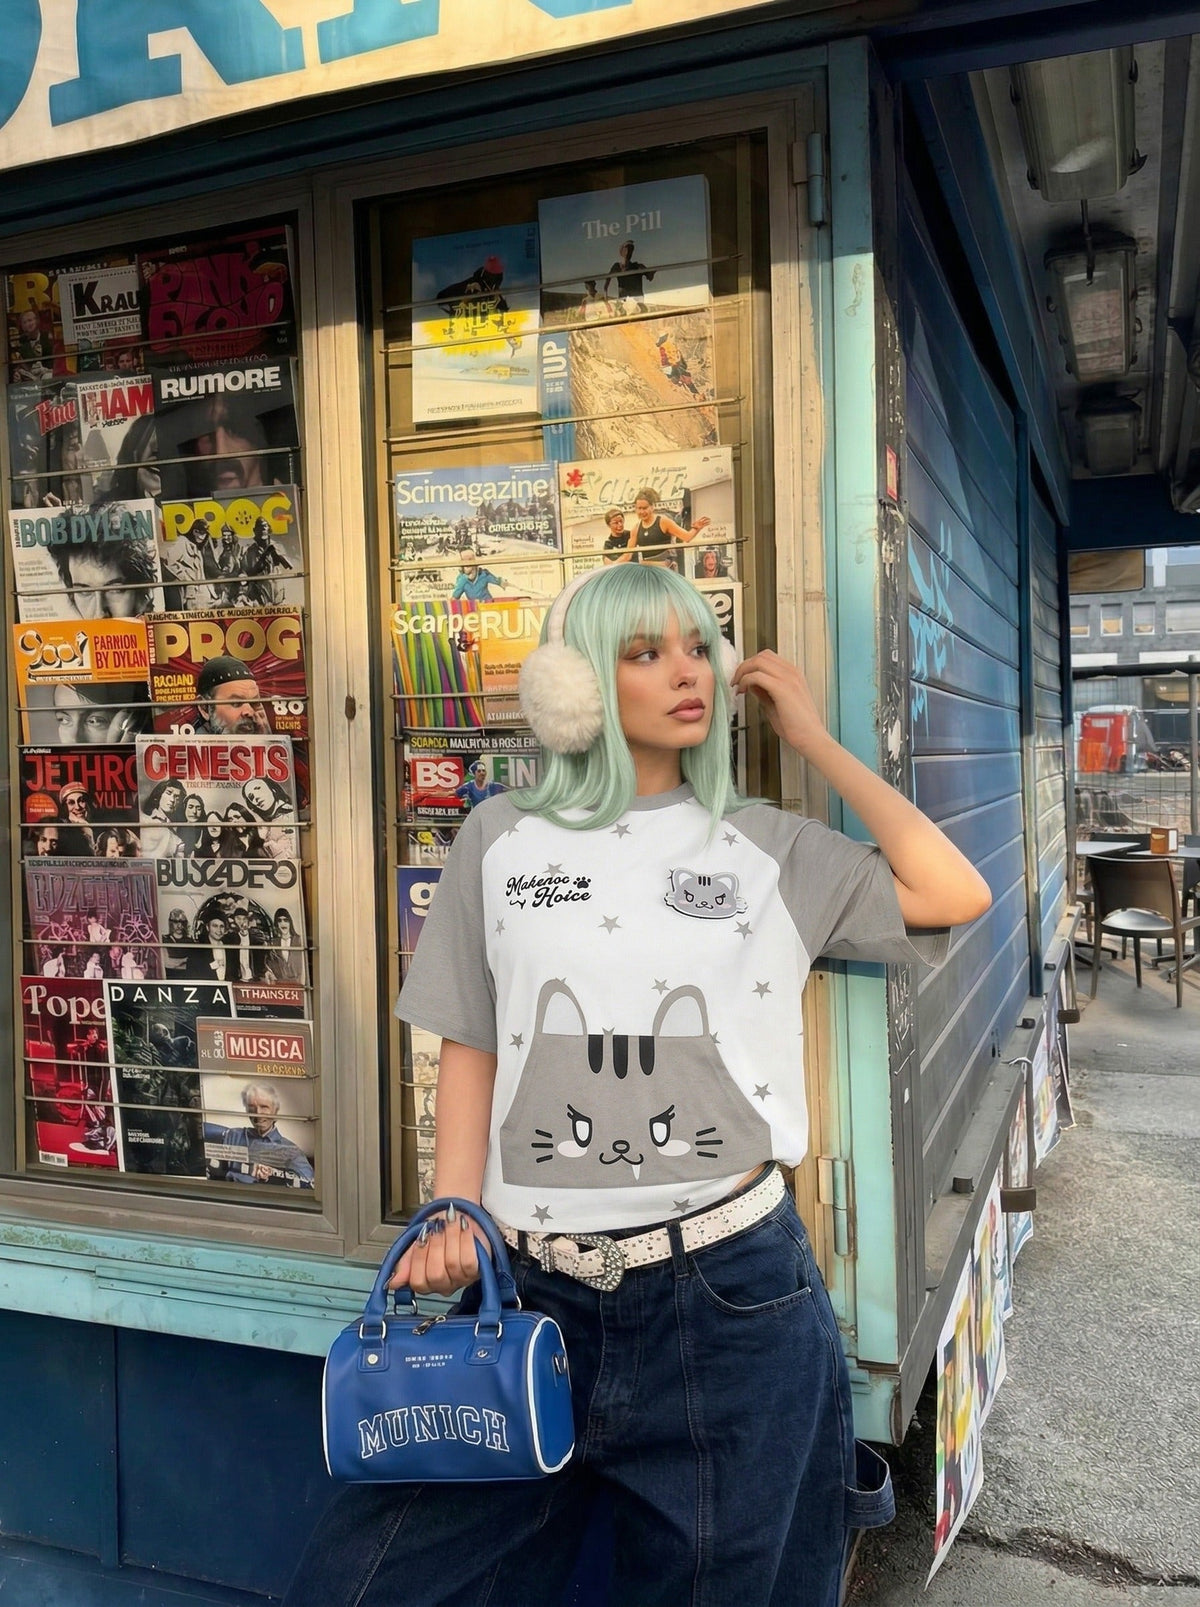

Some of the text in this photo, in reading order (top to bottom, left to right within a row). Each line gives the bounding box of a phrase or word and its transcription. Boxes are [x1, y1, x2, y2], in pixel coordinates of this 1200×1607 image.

[581, 209, 663, 240] The Pill
[396, 474, 549, 507] Scimagazine
[20, 516, 68, 548] BOB
[71, 509, 154, 544] DYLAN
[162, 492, 294, 541] PROG
[154, 616, 301, 664] PROG
[95, 650, 148, 669] BY DYLAN
[143, 743, 290, 783] GENESIS
[415, 761, 460, 788] BS
[156, 859, 297, 889] BUSCADERO
[110, 985, 227, 1004] DANZA
[229, 1036, 304, 1060] MUSICA
[357, 1404, 511, 1460] MUNICH
